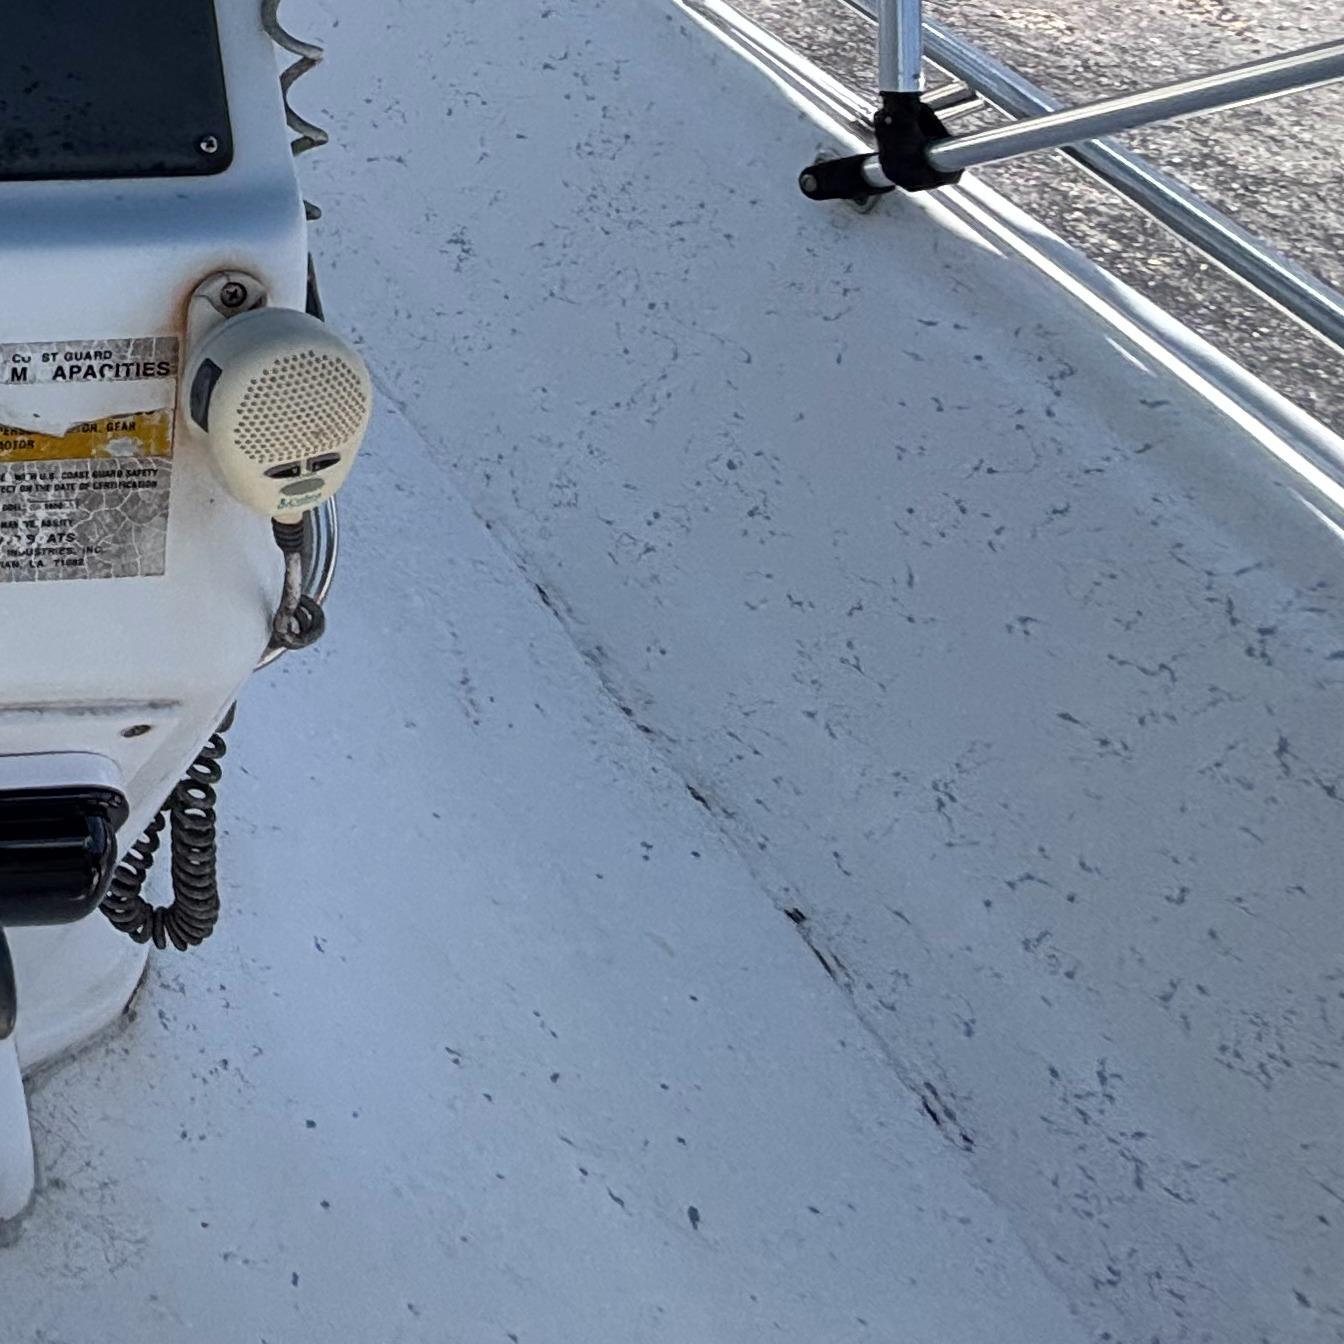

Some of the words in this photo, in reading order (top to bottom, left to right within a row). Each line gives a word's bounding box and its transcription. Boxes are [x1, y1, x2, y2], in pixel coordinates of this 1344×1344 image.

[12, 352, 58, 363] COST
[64, 350, 113, 362] GUARD
[52, 361, 171, 381] APACITIES
[61, 470, 89, 480] COAST
[92, 469, 122, 479] GUARD
[125, 468, 158, 477] SAFETY
[35, 483, 51, 492] THE
[54, 482, 76, 491] DATE
